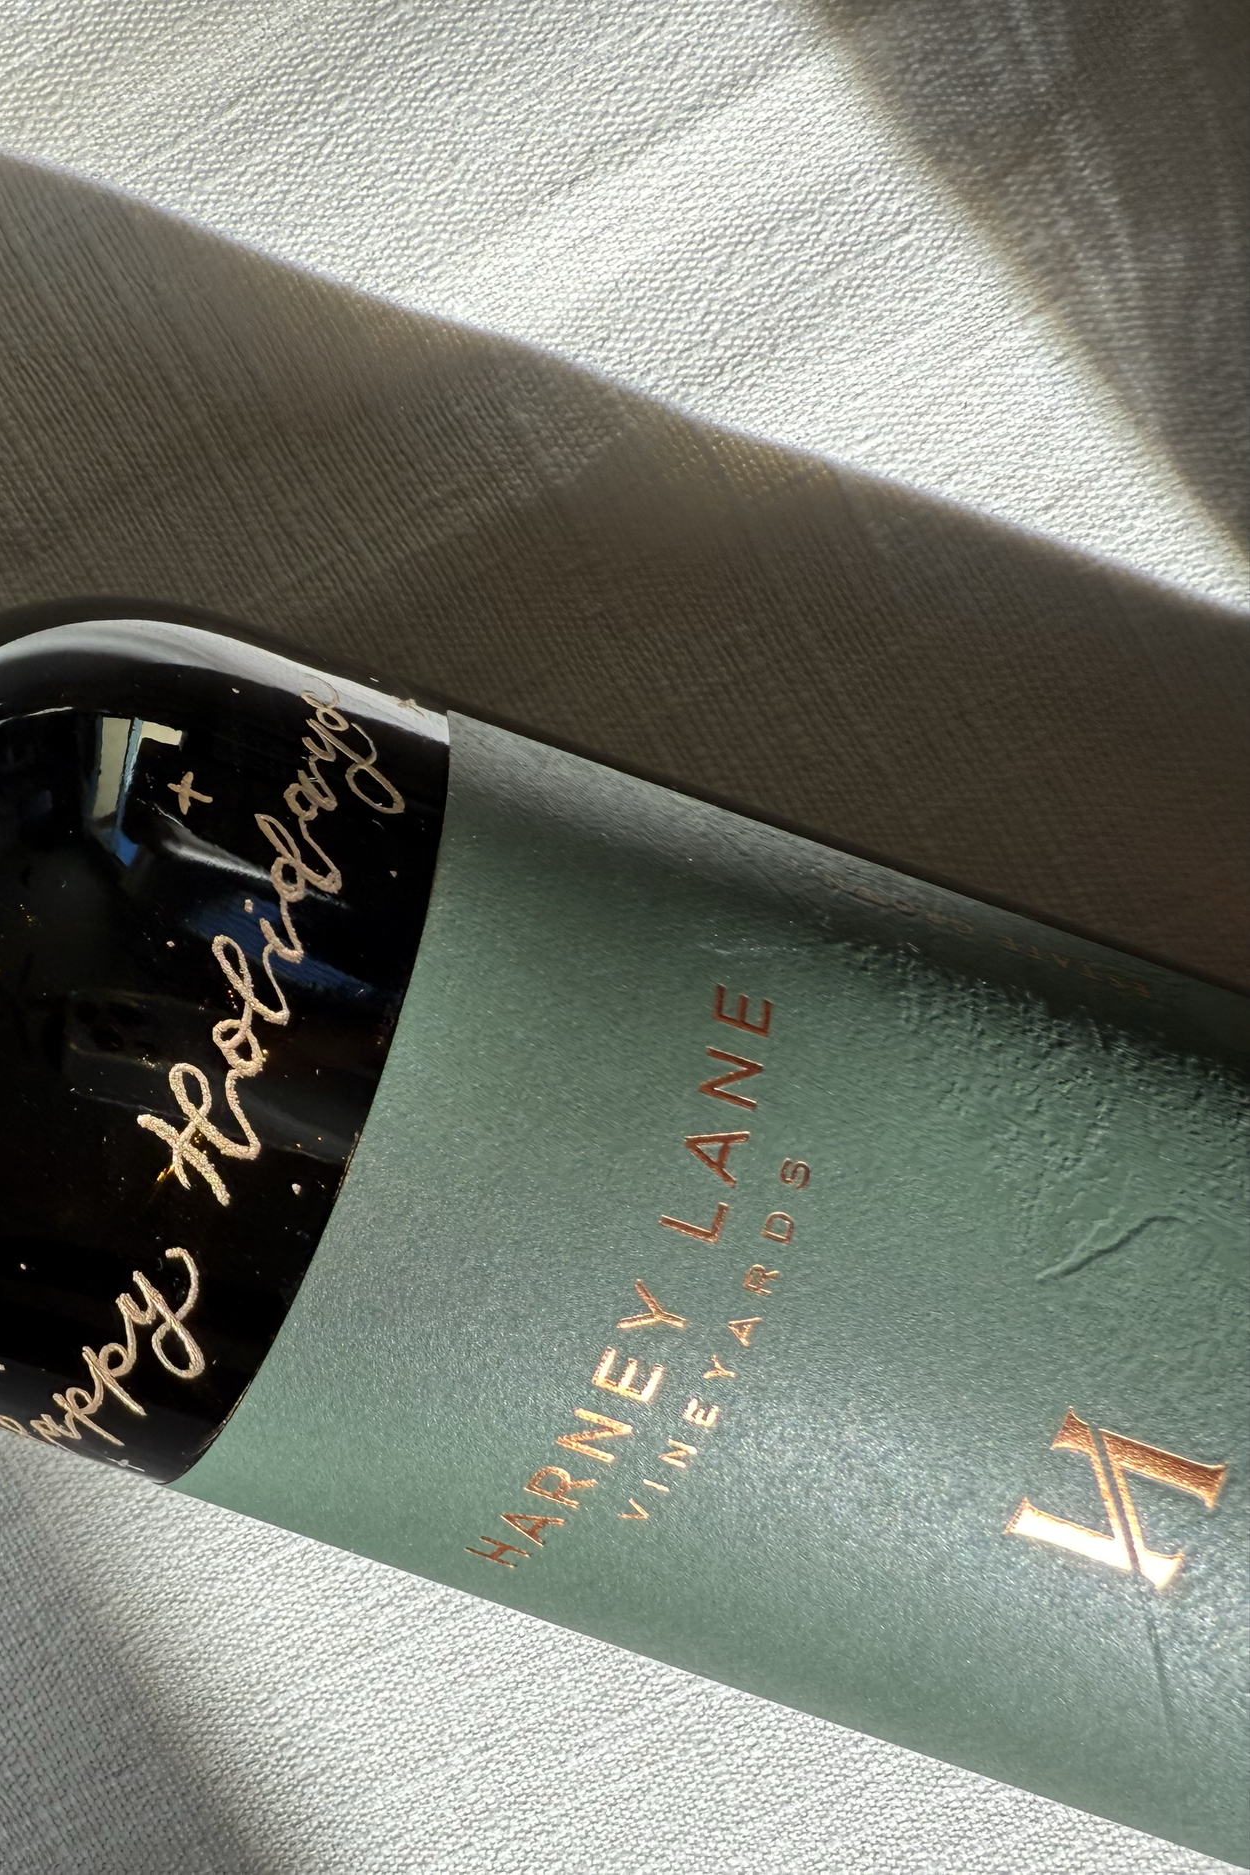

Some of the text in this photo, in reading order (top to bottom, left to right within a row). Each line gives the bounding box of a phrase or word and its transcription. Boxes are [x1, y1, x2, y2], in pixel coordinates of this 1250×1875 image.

[137, 673, 405, 1206] Holidays
[464, 983, 774, 1569] HARNEY LANE
[617, 1157, 811, 1520] VINEYARDS
